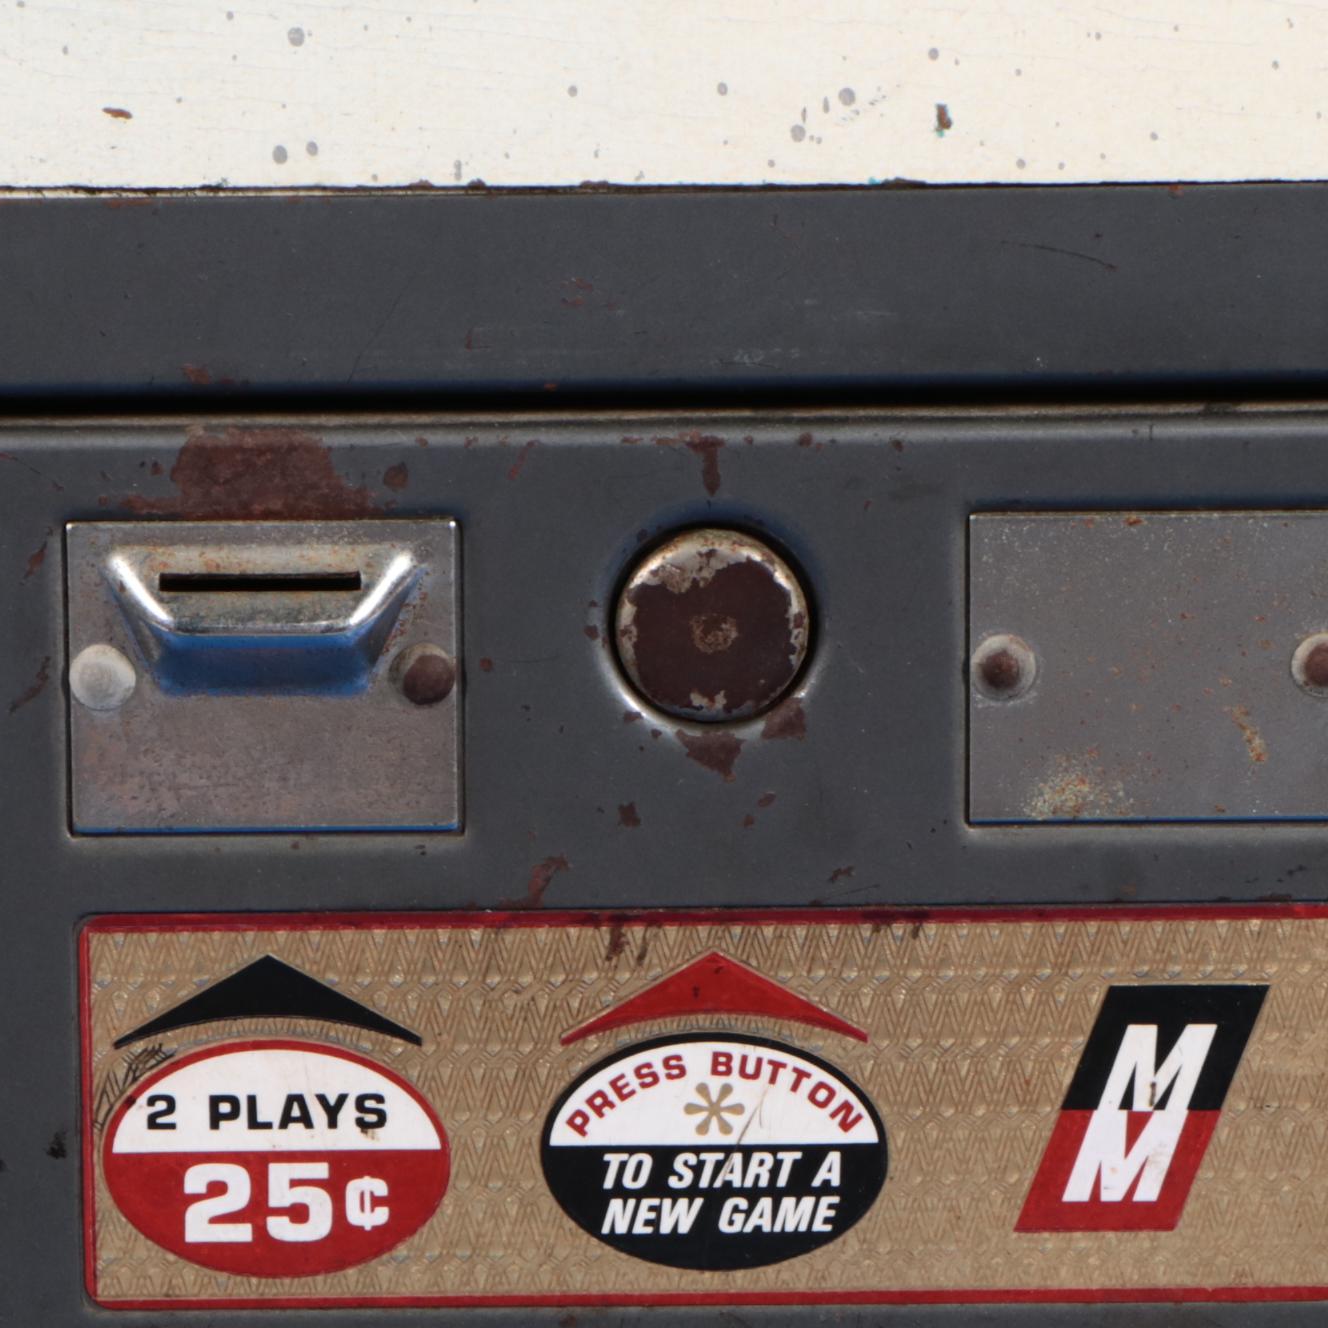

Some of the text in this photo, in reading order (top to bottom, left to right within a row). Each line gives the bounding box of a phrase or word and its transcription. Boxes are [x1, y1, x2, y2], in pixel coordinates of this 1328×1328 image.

[146, 1093, 388, 1130] 2 PLAYS
[566, 1051, 864, 1137] PRESS BUTTON
[602, 1151, 842, 1189] TO START A
[183, 1161, 390, 1243] 25¢
[600, 1195, 841, 1234] NEW GAME
